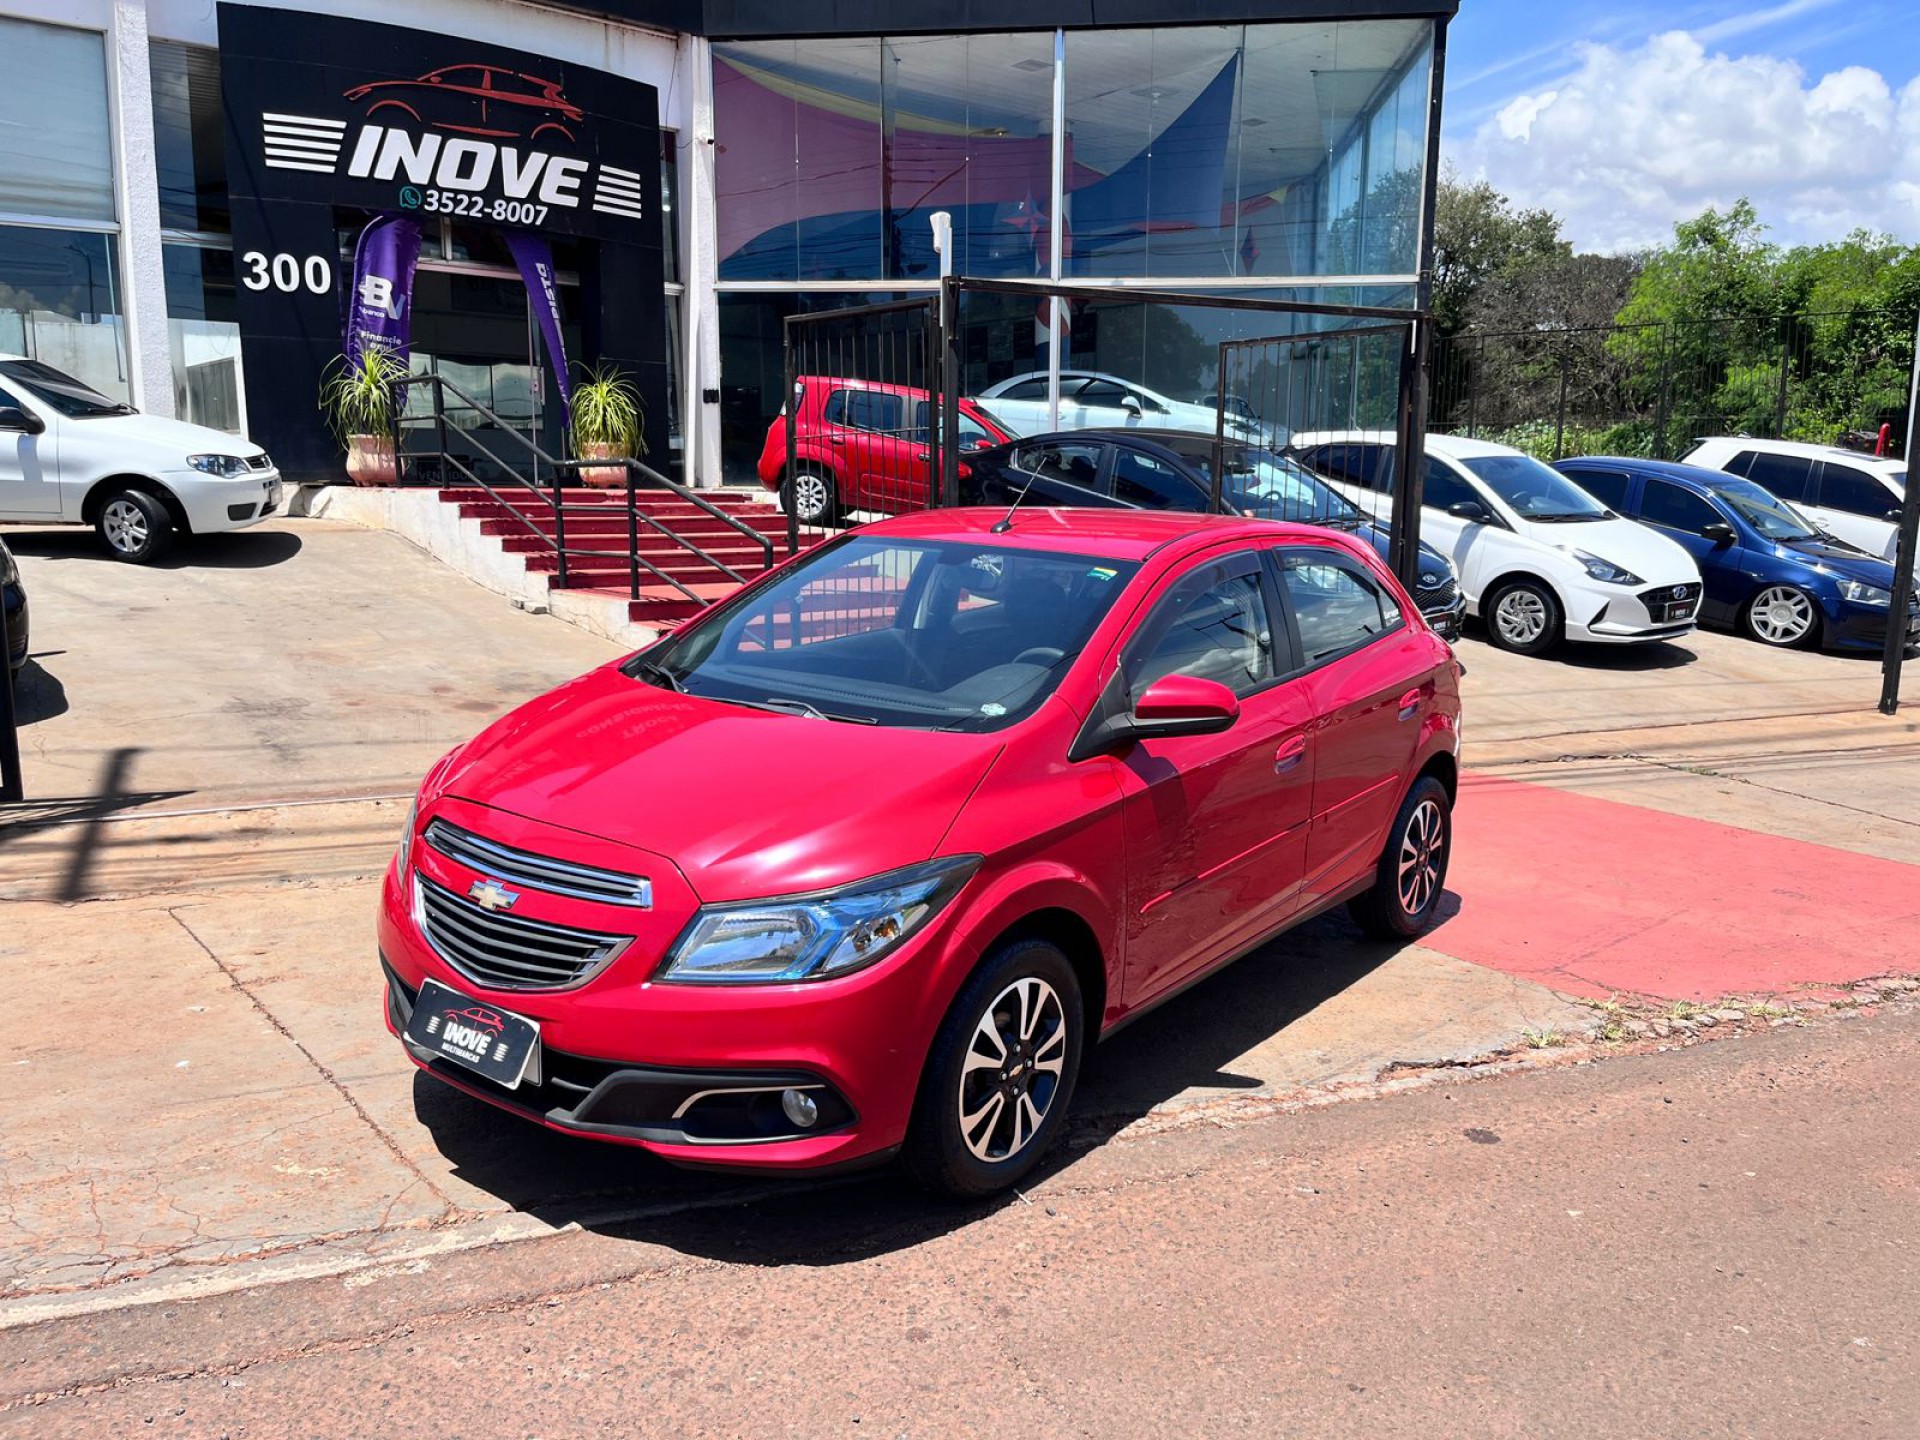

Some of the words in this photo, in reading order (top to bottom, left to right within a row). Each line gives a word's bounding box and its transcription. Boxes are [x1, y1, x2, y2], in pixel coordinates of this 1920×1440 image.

[347, 125, 589, 208] INOVE
[424, 189, 549, 226] 3522-8007
[242, 251, 331, 294] 300
[362, 308, 385, 318] banco
[443, 1021, 491, 1055] INOVE
